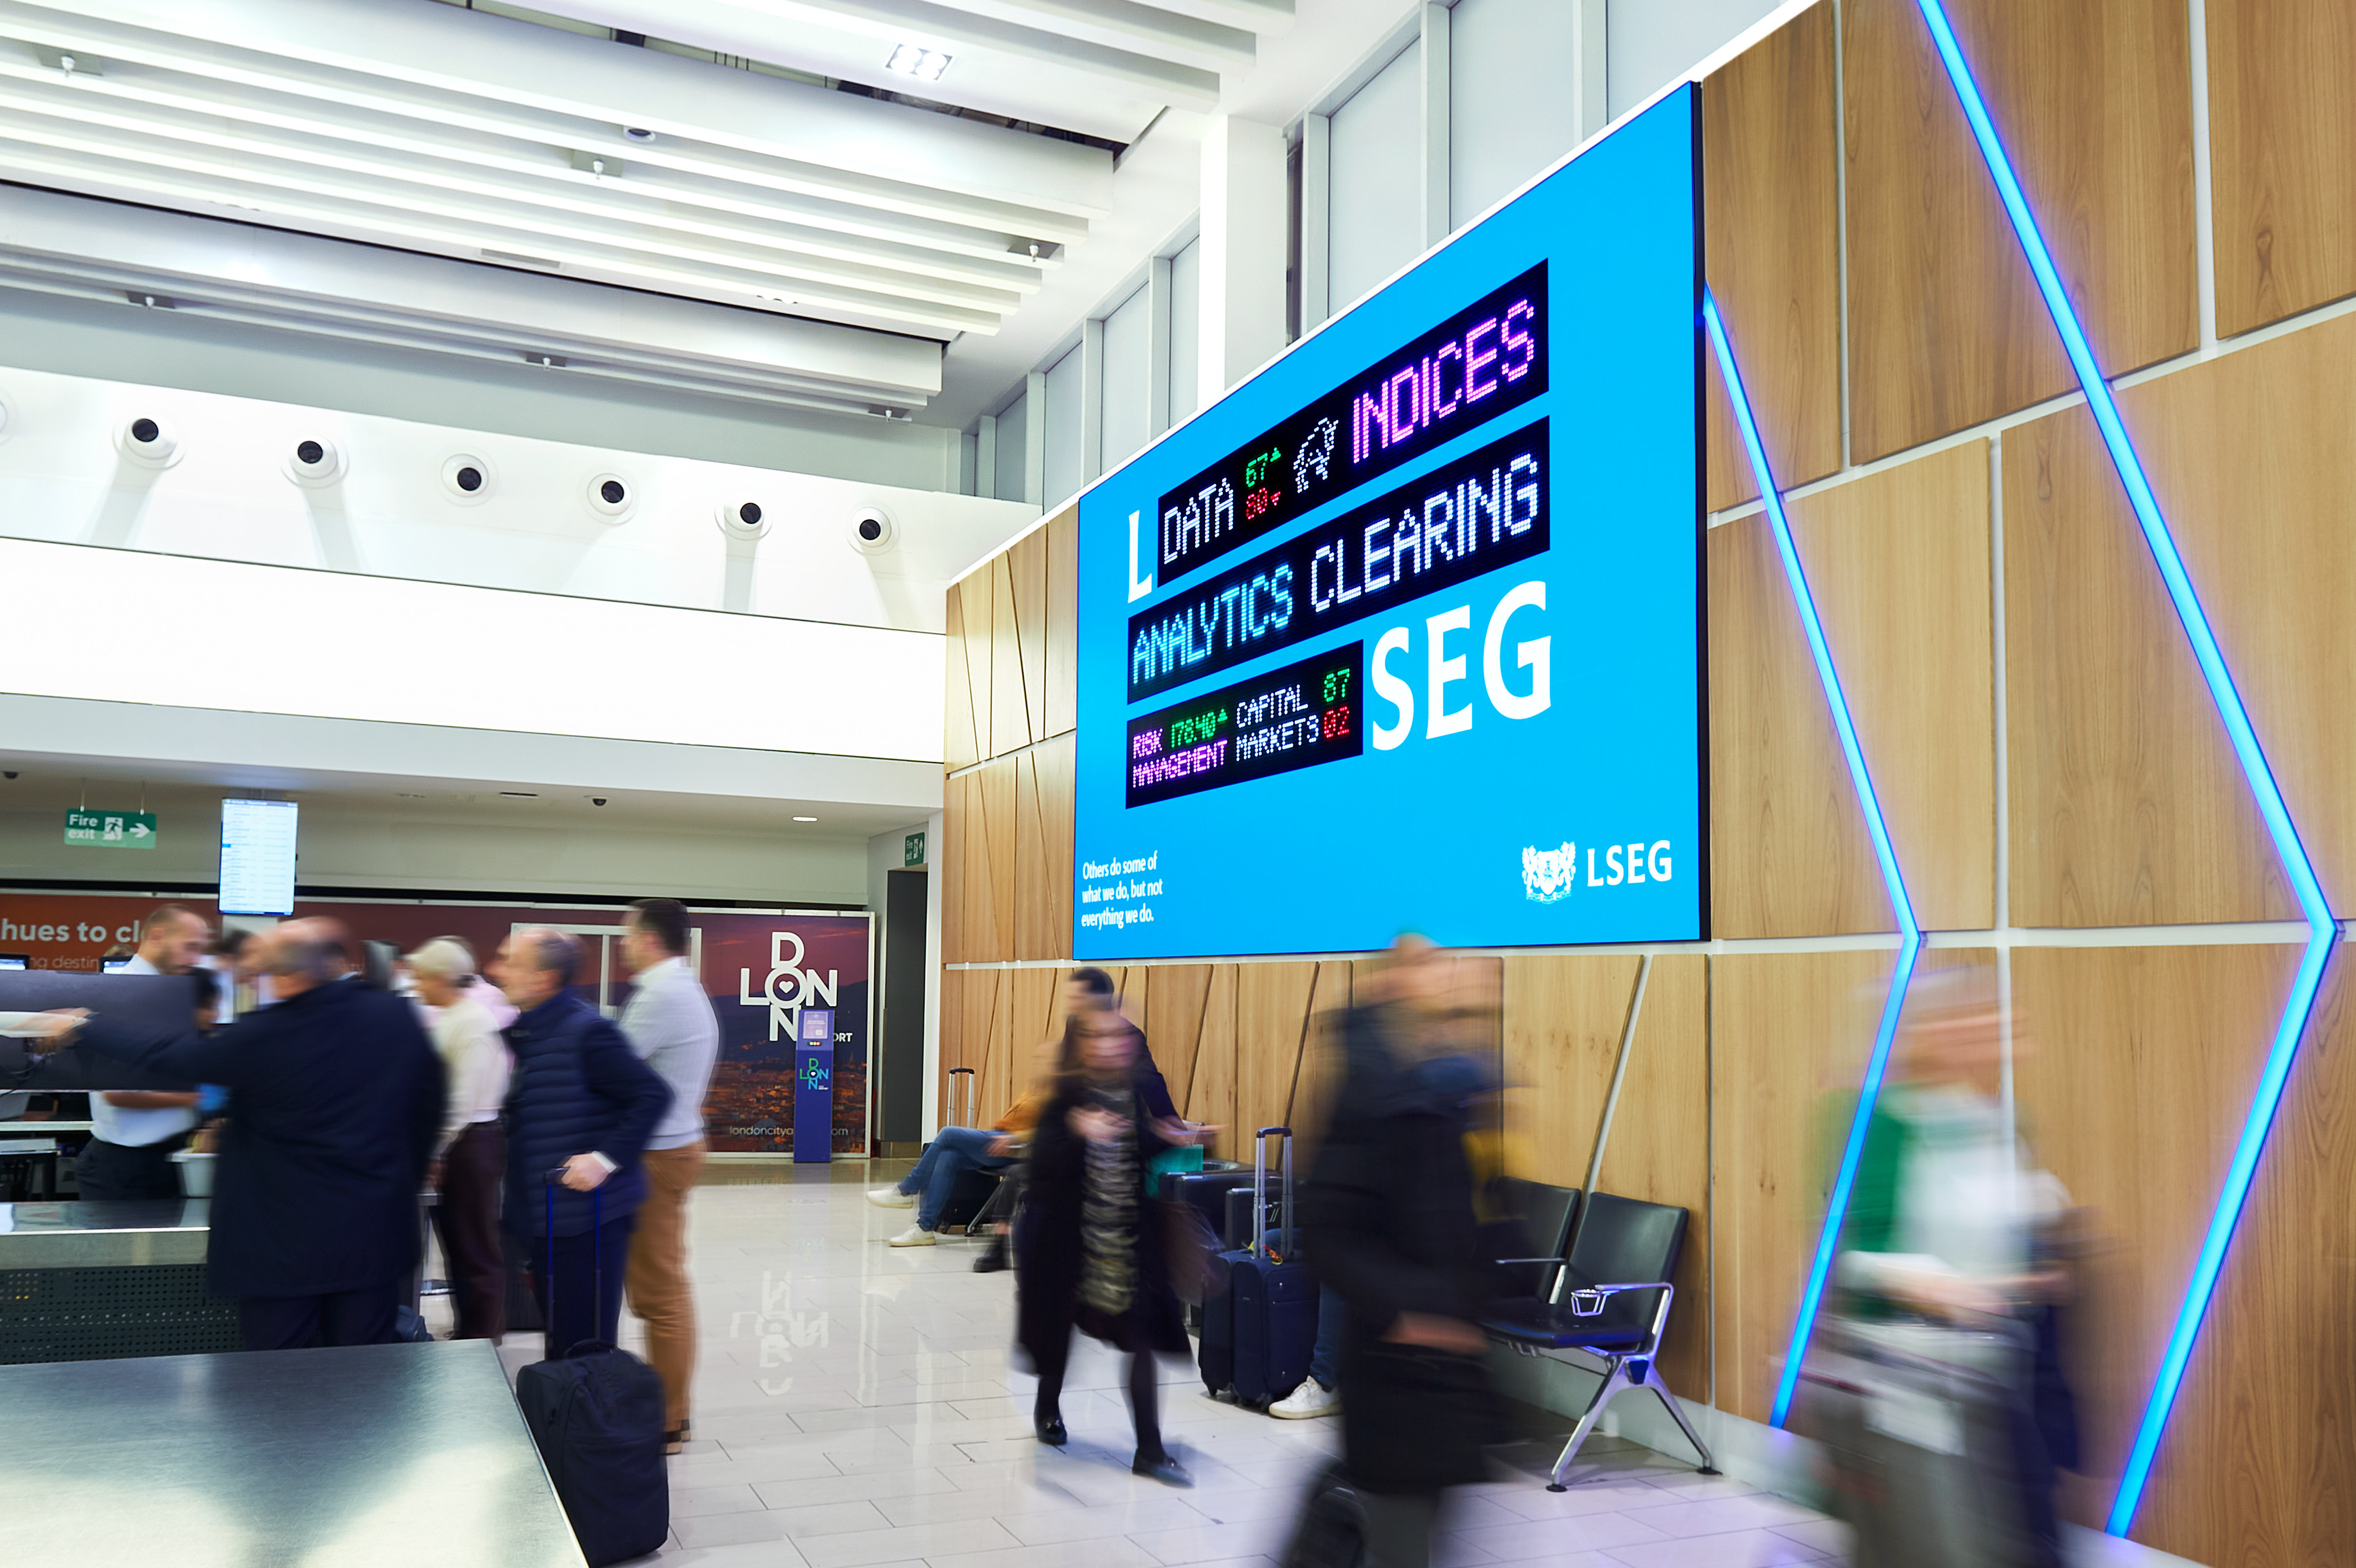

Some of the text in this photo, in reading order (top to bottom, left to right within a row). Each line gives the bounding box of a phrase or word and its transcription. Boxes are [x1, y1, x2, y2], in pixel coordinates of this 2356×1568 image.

[1353, 298, 1535, 464] INDICES
[1246, 453, 1268, 488] 67
[1246, 487, 1268, 520] 80
[1164, 478, 1234, 565] DATA
[1127, 509, 1152, 603] L
[1133, 453, 1538, 684] ANALYTICS CLEARING
[1371, 581, 1552, 750] SEG
[1324, 668, 1350, 702] 87
[1236, 684, 1308, 728] CAPITAL
[1323, 706, 1350, 739] 02
[1133, 728, 1163, 759] RISK
[1236, 715, 1319, 762] MARKETS
[1133, 740, 1228, 788] MANAGEMENT
[68, 828, 95, 840] exit
[69, 814, 98, 827] Fire
[1082, 850, 1158, 880] Others do some of
[1587, 840, 1672, 887] LSEG
[1082, 878, 1163, 903] what we do, but not
[1, 918, 144, 943] hues to cl
[1081, 902, 1154, 930] everything we do.
[52, 956, 99, 969] destin
[833, 1032, 853, 1042] ORT
